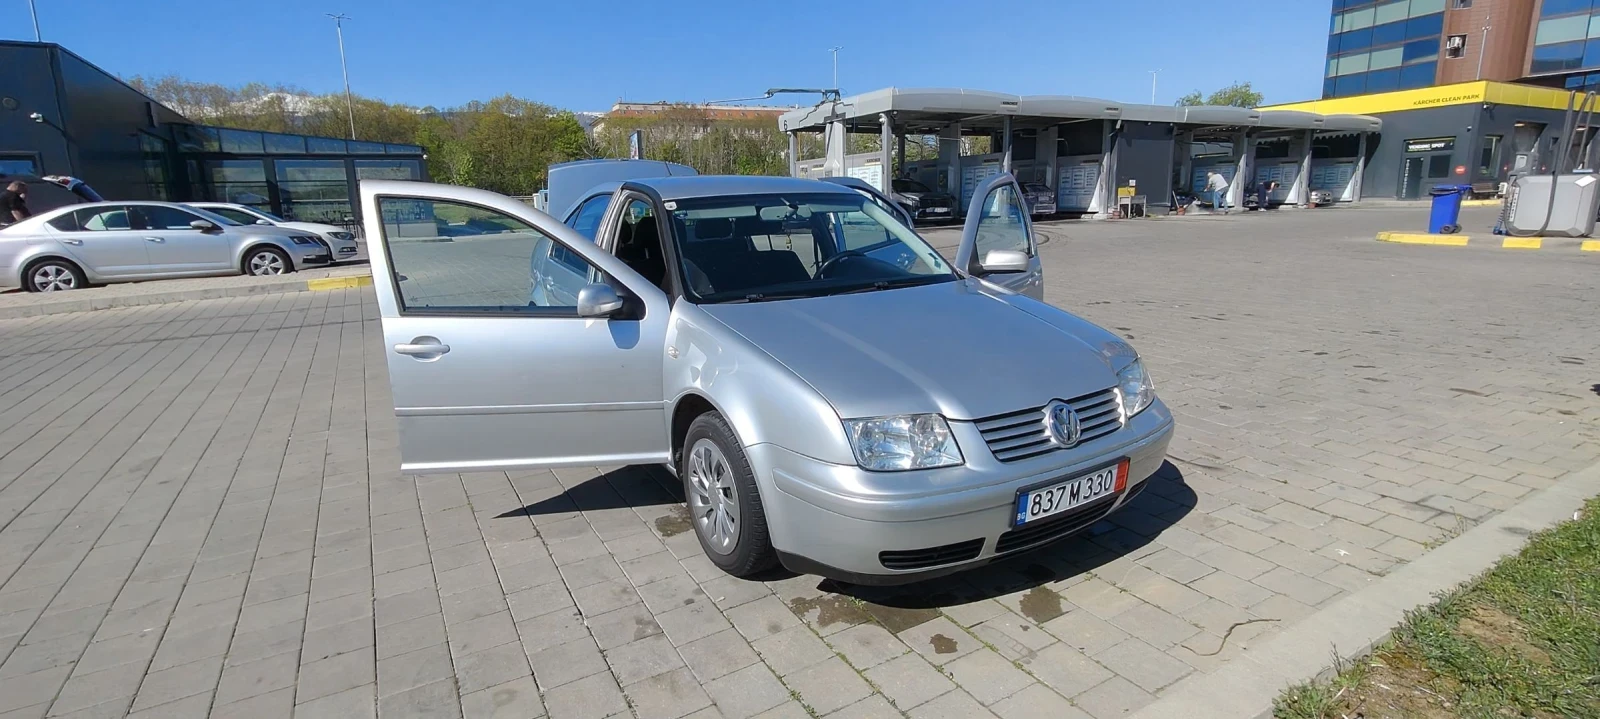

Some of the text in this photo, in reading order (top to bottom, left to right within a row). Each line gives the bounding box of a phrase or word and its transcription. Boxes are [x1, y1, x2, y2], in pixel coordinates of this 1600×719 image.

[1441, 95, 1461, 103] CLEAN
[783, 120, 788, 130] 6
[1031, 486, 1066, 516] 837
[1069, 482, 1081, 505] M
[1083, 470, 1113, 499] 330
